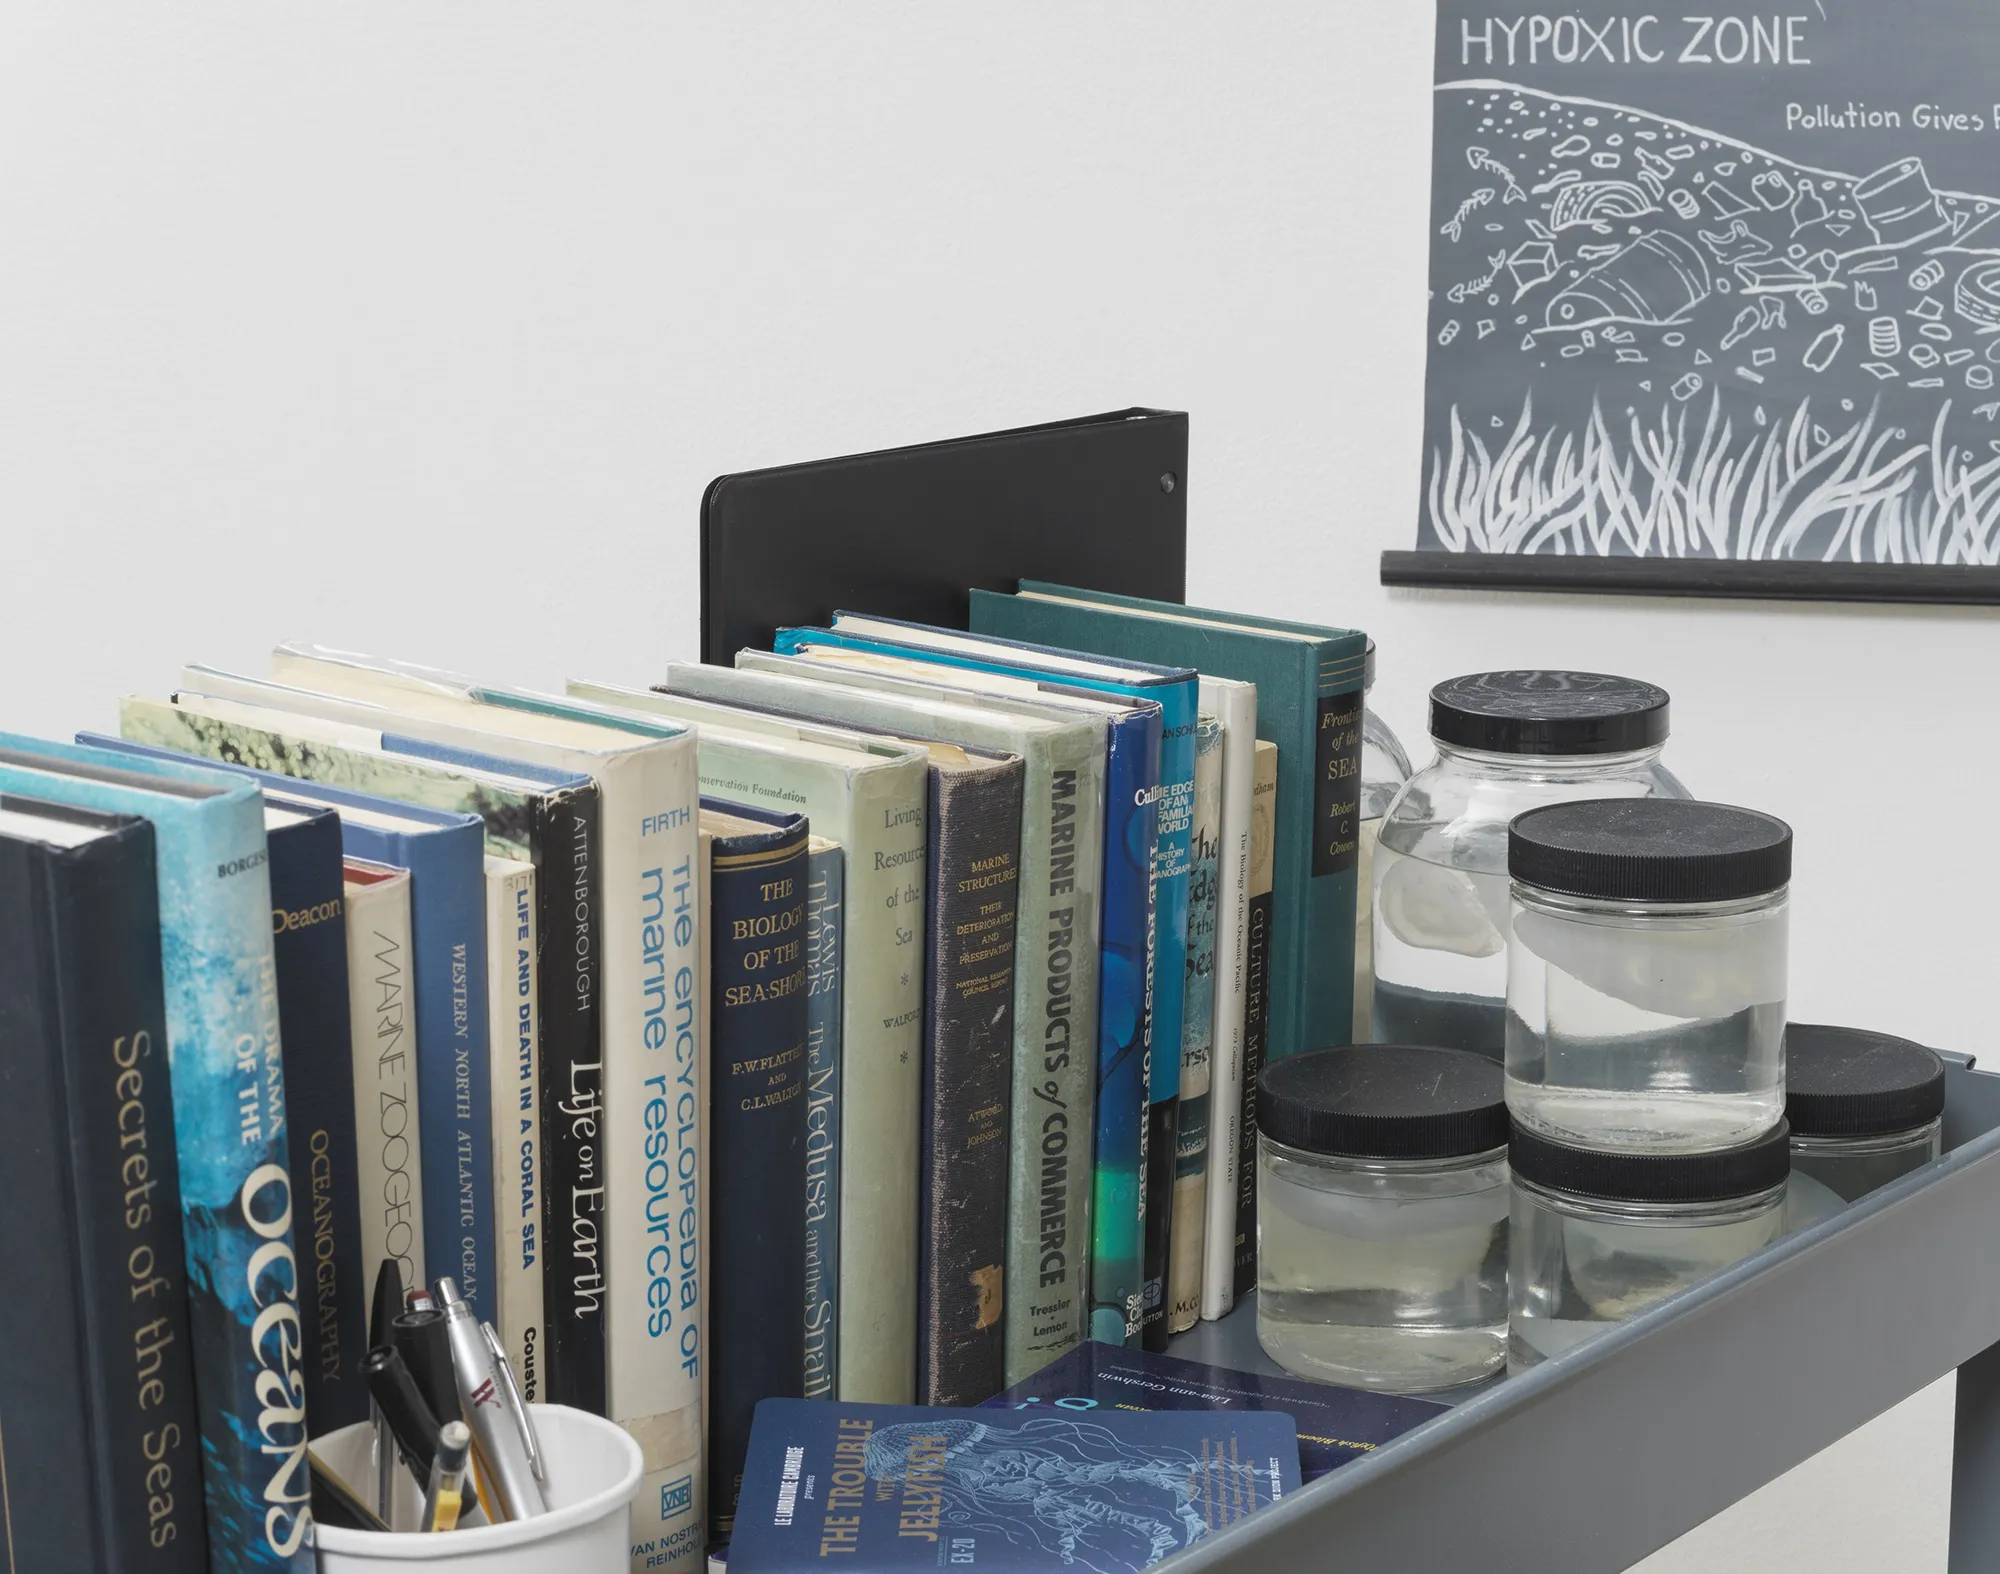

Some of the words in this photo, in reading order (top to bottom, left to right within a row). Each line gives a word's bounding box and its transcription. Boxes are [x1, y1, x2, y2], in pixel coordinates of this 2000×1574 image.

[1462, 16, 1664, 65] HYPOXIC
[1678, 16, 1811, 64] ZONE
[1786, 101, 1901, 130] Pollution
[1912, 103, 1984, 131] Gives
[1332, 731, 1344, 751] of
[1346, 728, 1359, 747] the
[1171, 780, 1195, 797] EDGE
[1328, 756, 1358, 780] SEA
[752, 784, 807, 804] Foundation
[1158, 797, 1173, 811] OF
[1173, 794, 1189, 809] AN
[1330, 799, 1356, 818] Robert
[642, 805, 691, 837] FIRTH
[884, 804, 923, 829] Living
[1049, 769, 1077, 897] MARINE
[1240, 831, 1248, 850] The
[971, 852, 1011, 873] MARINE
[1165, 859, 1177, 869] OF
[1237, 853, 1247, 890] Biology
[760, 877, 794, 902] THE
[886, 886, 900, 909] of
[903, 882, 920, 904] the
[1238, 893, 1245, 903] of
[273, 898, 342, 935] Deacon
[516, 889, 530, 942] LIFE
[573, 815, 591, 1012] ATTENBOROUGH
[807, 869, 827, 998] Thomas
[743, 949, 772, 970] OF
[774, 939, 801, 965] THE
[822, 901, 840, 993] Lewis
[896, 926, 914, 947] Sea
[981, 932, 1000, 946] AND
[1236, 924, 1244, 962] Oceanic
[517, 948, 530, 998] AND
[641, 867, 667, 1051] marine
[1234, 964, 1243, 994] Pacific
[1250, 908, 1264, 1024] CULTURE
[373, 931, 406, 1080] MARINE
[451, 943, 468, 1040] WESTERN
[1044, 905, 1075, 1073] PRODUCTS
[235, 1033, 257, 1074] OF
[519, 1003, 532, 1082] DEATH
[807, 1021, 824, 1065] The
[263, 1019, 284, 1138] DRAMA
[454, 1049, 470, 1120] NORTH
[520, 1085, 533, 1112] IN
[767, 1072, 787, 1086] AND
[1033, 1080, 1068, 1110] of
[1244, 1034, 1258, 1150] METHODS
[238, 1081, 262, 1146] THE
[558, 1059, 605, 1140] Life
[113, 1030, 158, 1230] Secrets
[520, 1118, 533, 1136] A
[805, 1060, 834, 1228] Medusa
[457, 1129, 475, 1228] ATLANTIC
[520, 1139, 536, 1219] CORAL
[578, 1145, 595, 1182] on
[1241, 1160, 1254, 1208] FOR
[643, 1074, 673, 1338] resources
[1040, 1112, 1069, 1288] COMMERCE
[310, 1129, 341, 1383] OCEANOGRAPHY
[522, 1223, 536, 1271] SEA
[571, 1183, 608, 1320] Earth
[804, 1229, 821, 1267] and
[128, 1244, 171, 1303] of
[460, 1236, 477, 1300] OCEAN
[804, 1267, 820, 1304] the
[1029, 1299, 1071, 1317] Tressler
[803, 1300, 833, 1399] Snail
[1033, 1321, 1068, 1337] Lemon
[134, 1316, 175, 1411] the
[523, 1326, 538, 1403] Couste
[679, 1323, 699, 1381] OF
[1098, 1371, 1166, 1391] Gershwin
[1169, 1386, 1233, 1405] Lisa-ann
[782, 1446, 805, 1480] CAMBRIDGE
[826, 1418, 874, 1511] TROUBLE
[1269, 1457, 1280, 1480] PROJECT
[143, 1422, 181, 1548] Seas
[775, 1481, 799, 1518] LABORATOIRE
[804, 1474, 816, 1500] presents
[875, 1473, 897, 1501] WITH
[898, 1435, 949, 1542] JELLYFISH
[774, 1517, 792, 1526] LE
[819, 1516, 861, 1557] THE
